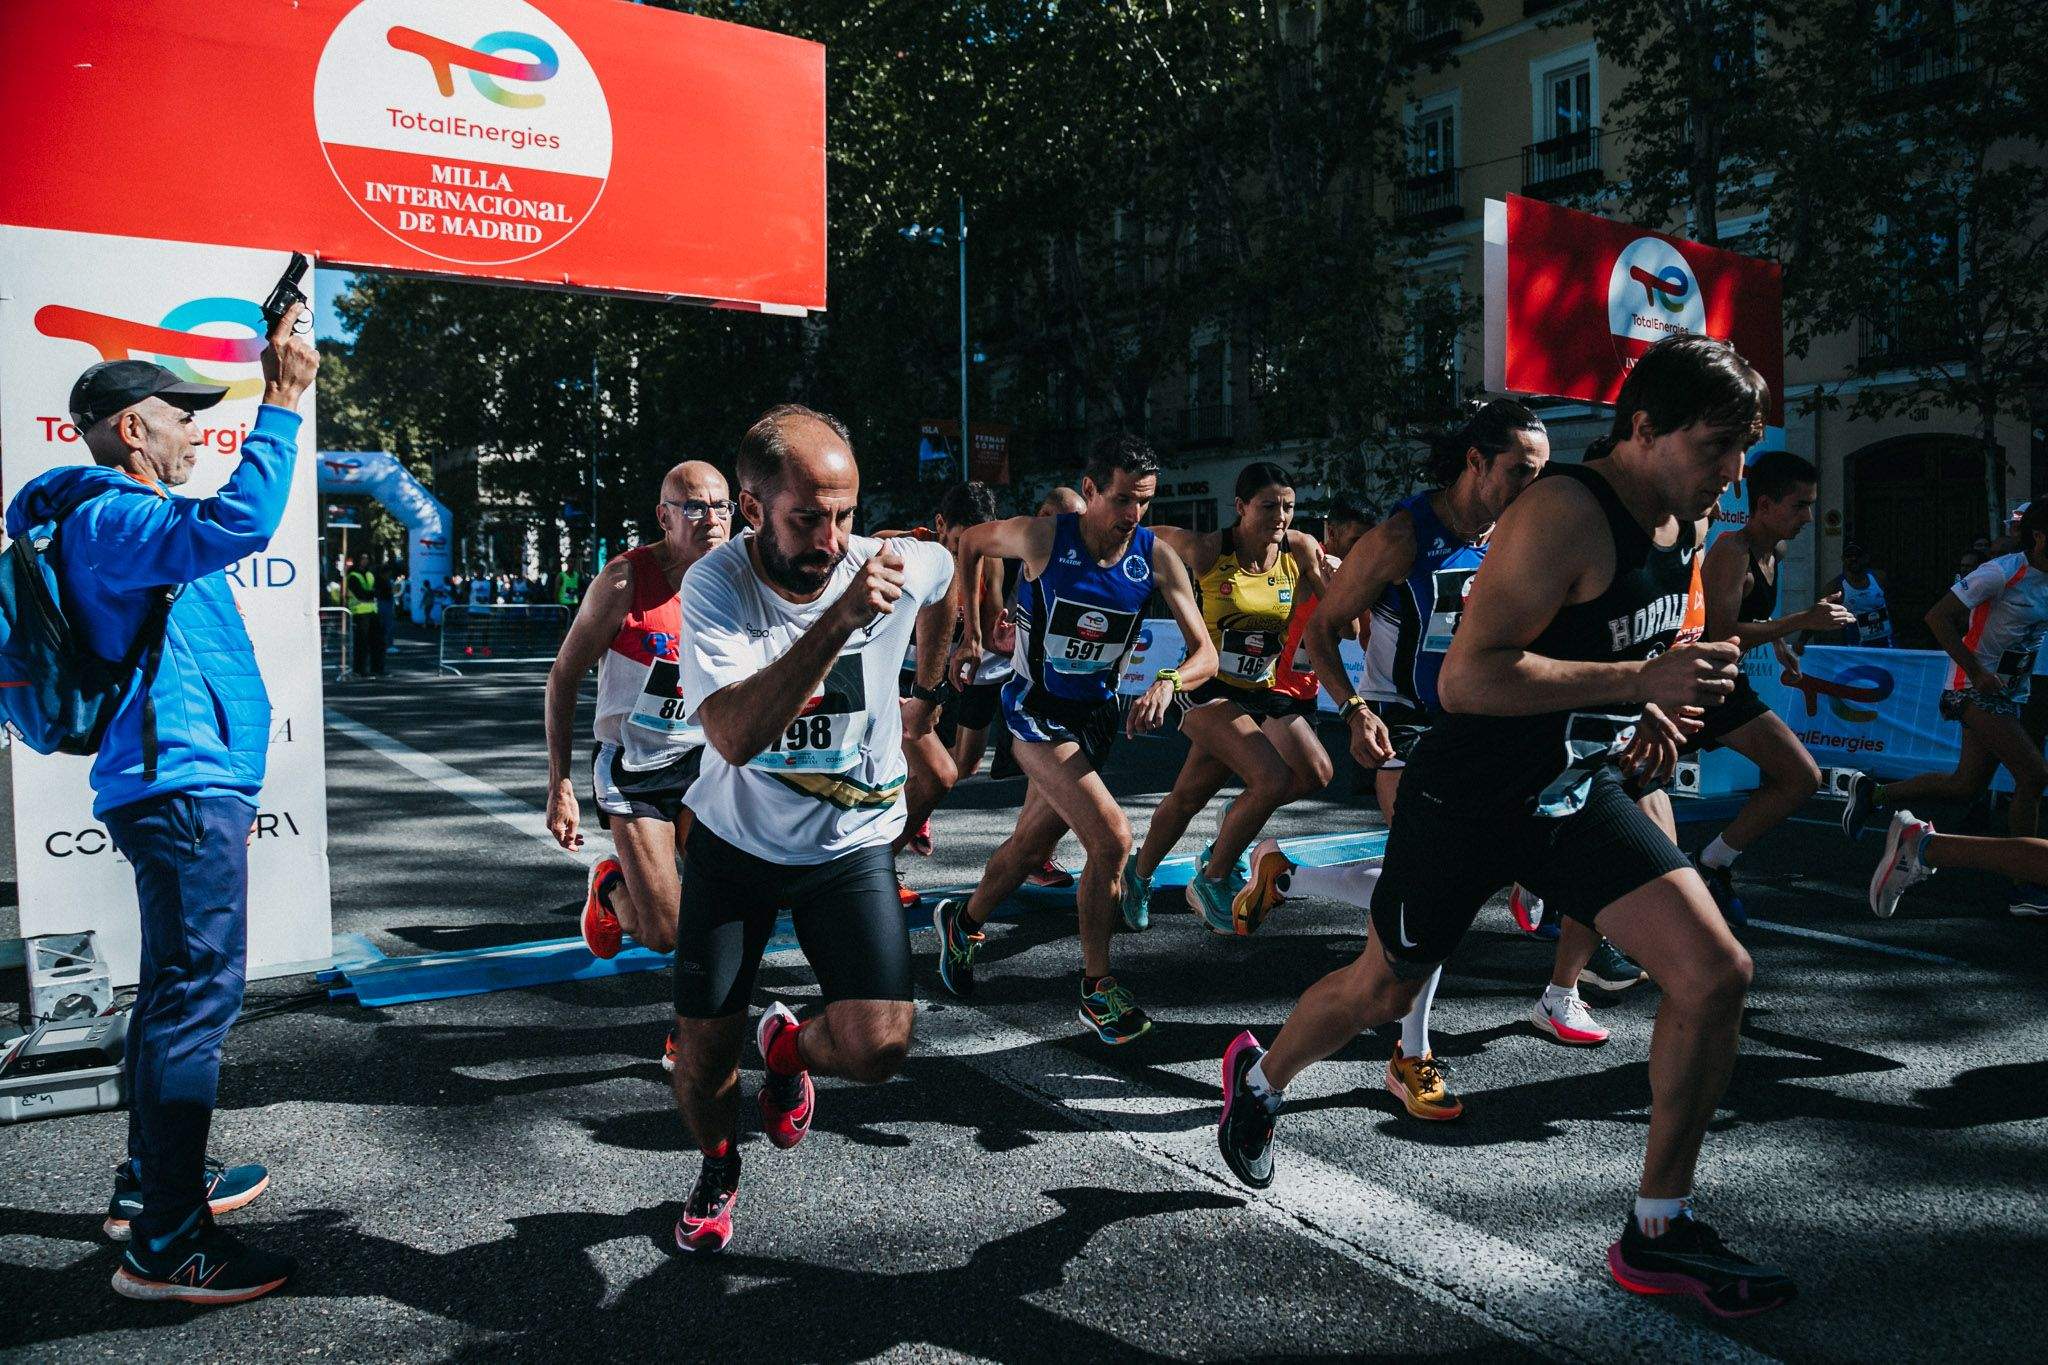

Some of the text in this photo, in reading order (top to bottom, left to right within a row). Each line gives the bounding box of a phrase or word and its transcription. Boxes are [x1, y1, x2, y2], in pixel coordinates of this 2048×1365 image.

[387, 108, 560, 149] TotalEnergies
[431, 164, 513, 192] MILLA
[399, 211, 542, 244] DE MADRID
[223, 558, 296, 587] RID
[1064, 638, 1105, 661] 591
[1237, 656, 1265, 675] 146
[1797, 730, 1885, 752] alEnergies
